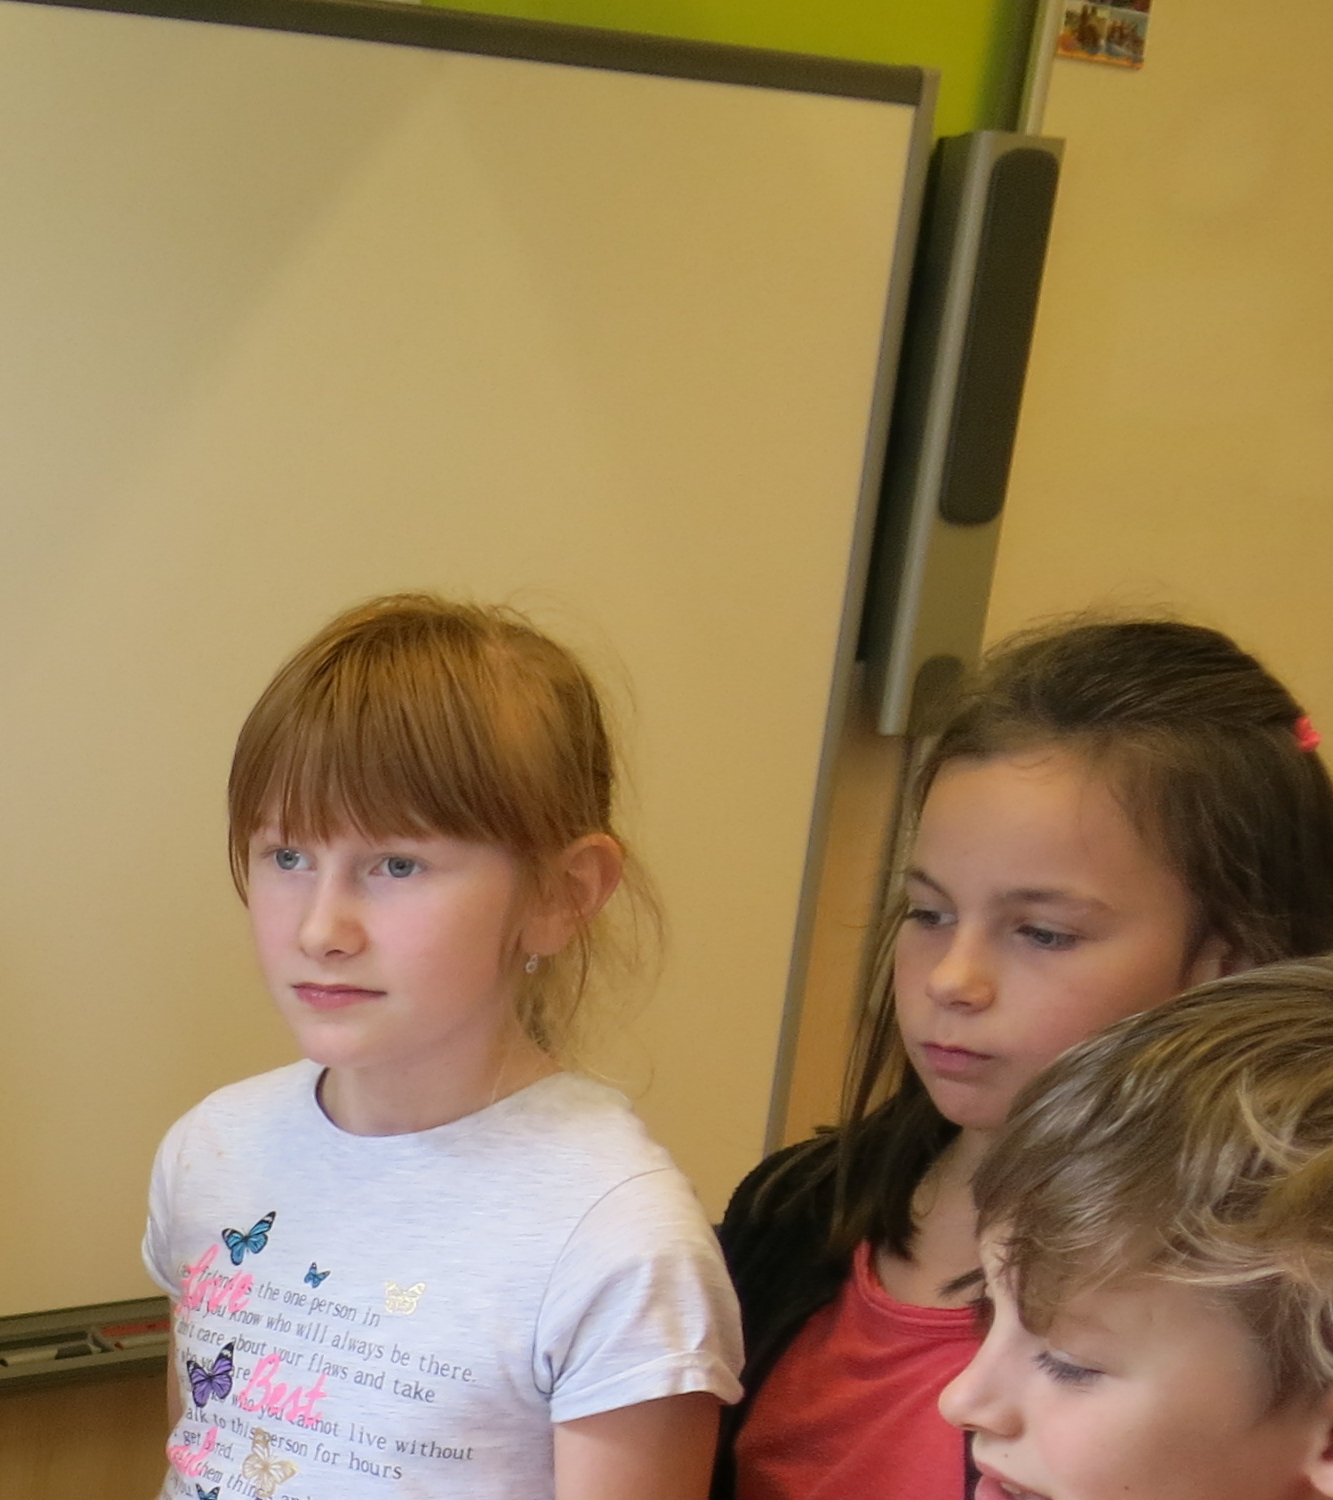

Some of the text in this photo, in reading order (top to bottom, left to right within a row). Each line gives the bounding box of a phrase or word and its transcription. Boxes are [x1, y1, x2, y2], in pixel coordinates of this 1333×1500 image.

[258, 1282, 380, 1327] the one person in
[197, 1327, 225, 1345] care
[231, 1333, 267, 1356] about
[308, 1353, 348, 1380] flaws
[354, 1370, 385, 1389] and
[394, 1379, 435, 1403] take
[266, 1313, 291, 1333] who
[296, 1322, 328, 1344] will
[332, 1331, 384, 1361] always
[391, 1344, 410, 1366] be
[419, 1354, 477, 1383] there.
[214, 1414, 226, 1429] to
[232, 1419, 255, 1440] this
[314, 1443, 340, 1465] for
[349, 1451, 402, 1480] hours
[349, 1423, 387, 1450] live
[395, 1439, 474, 1460] without
